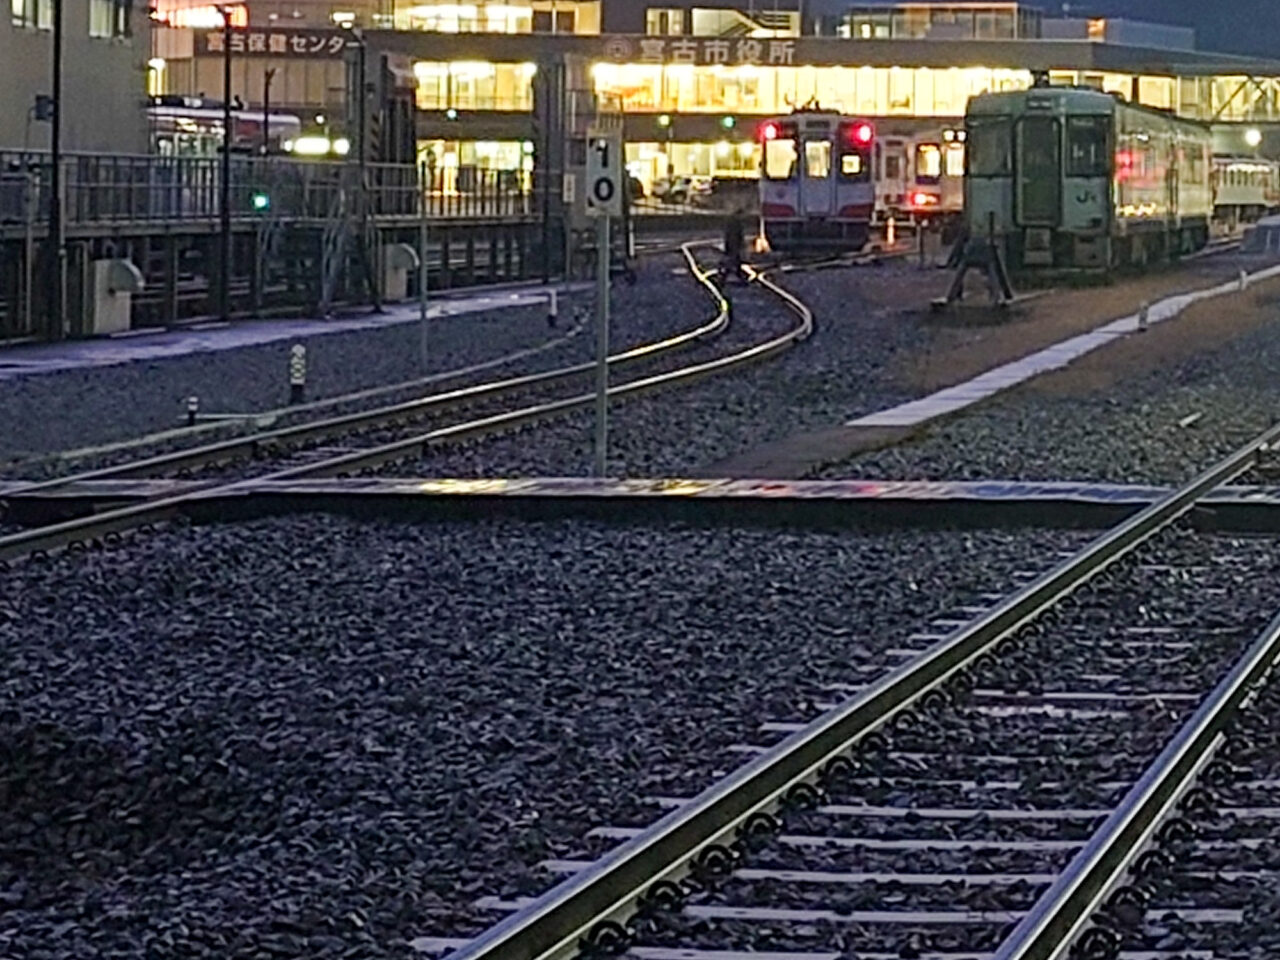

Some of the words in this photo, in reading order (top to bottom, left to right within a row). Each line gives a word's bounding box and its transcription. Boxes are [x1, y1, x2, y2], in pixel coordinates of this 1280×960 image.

[207, 33, 359, 54] 宮古保健センター
[640, 39, 795, 64] 宮古市役所
